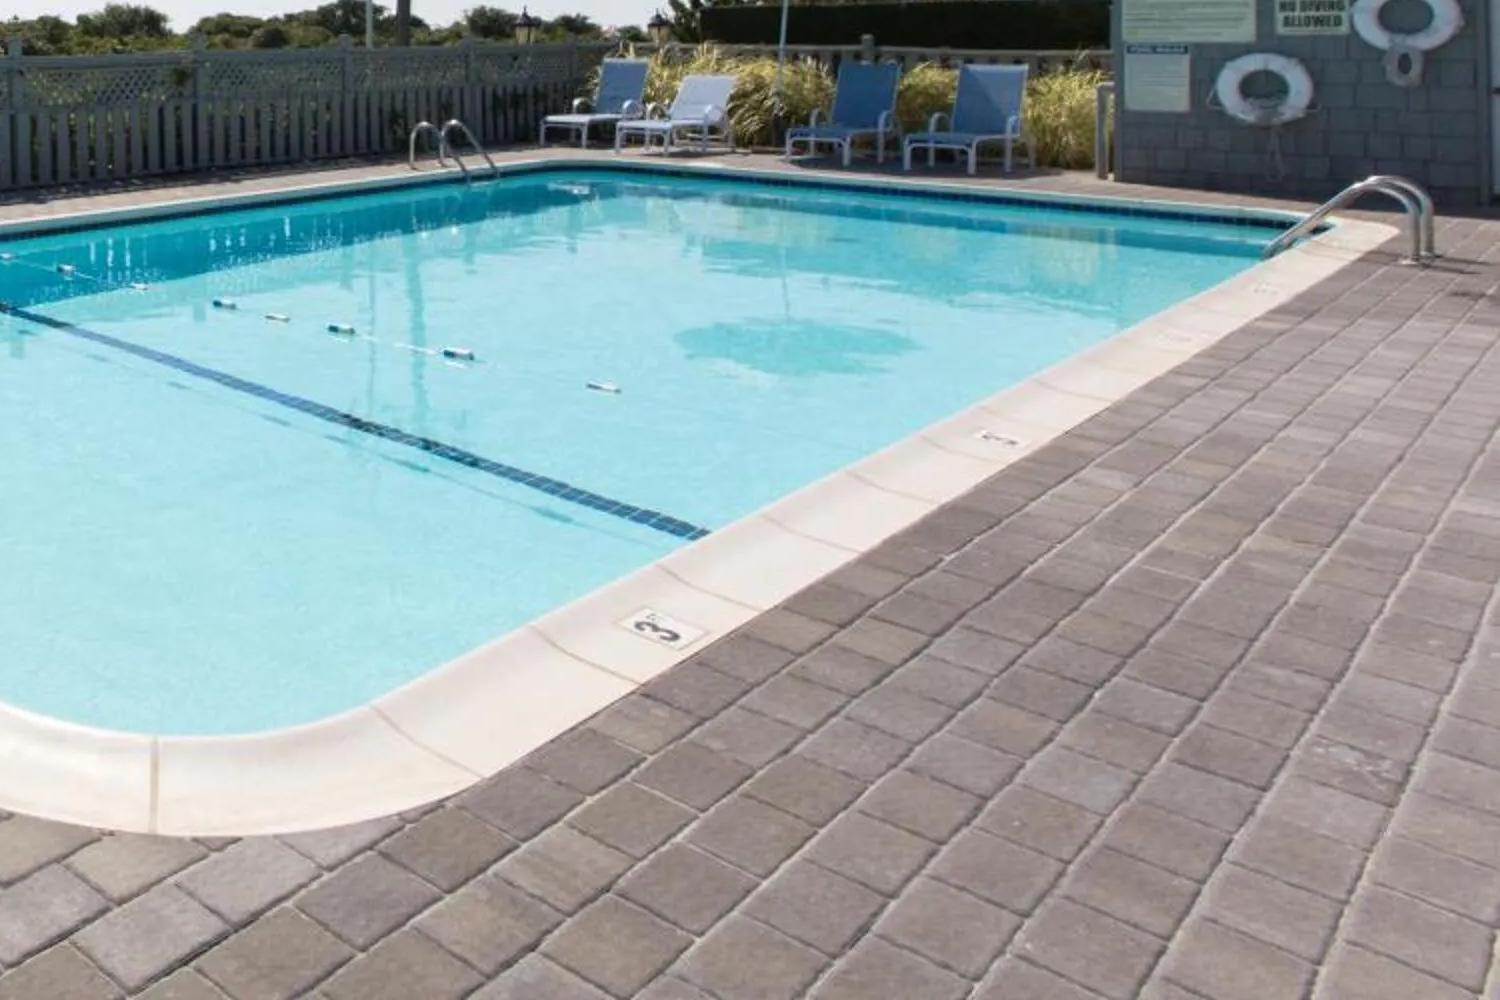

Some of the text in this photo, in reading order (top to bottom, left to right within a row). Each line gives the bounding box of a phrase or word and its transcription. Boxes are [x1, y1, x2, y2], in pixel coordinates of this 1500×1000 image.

[1279, 0, 1345, 13] NO DIVING
[1283, 14, 1343, 28] ALLOWED
[633, 620, 681, 642] 3
